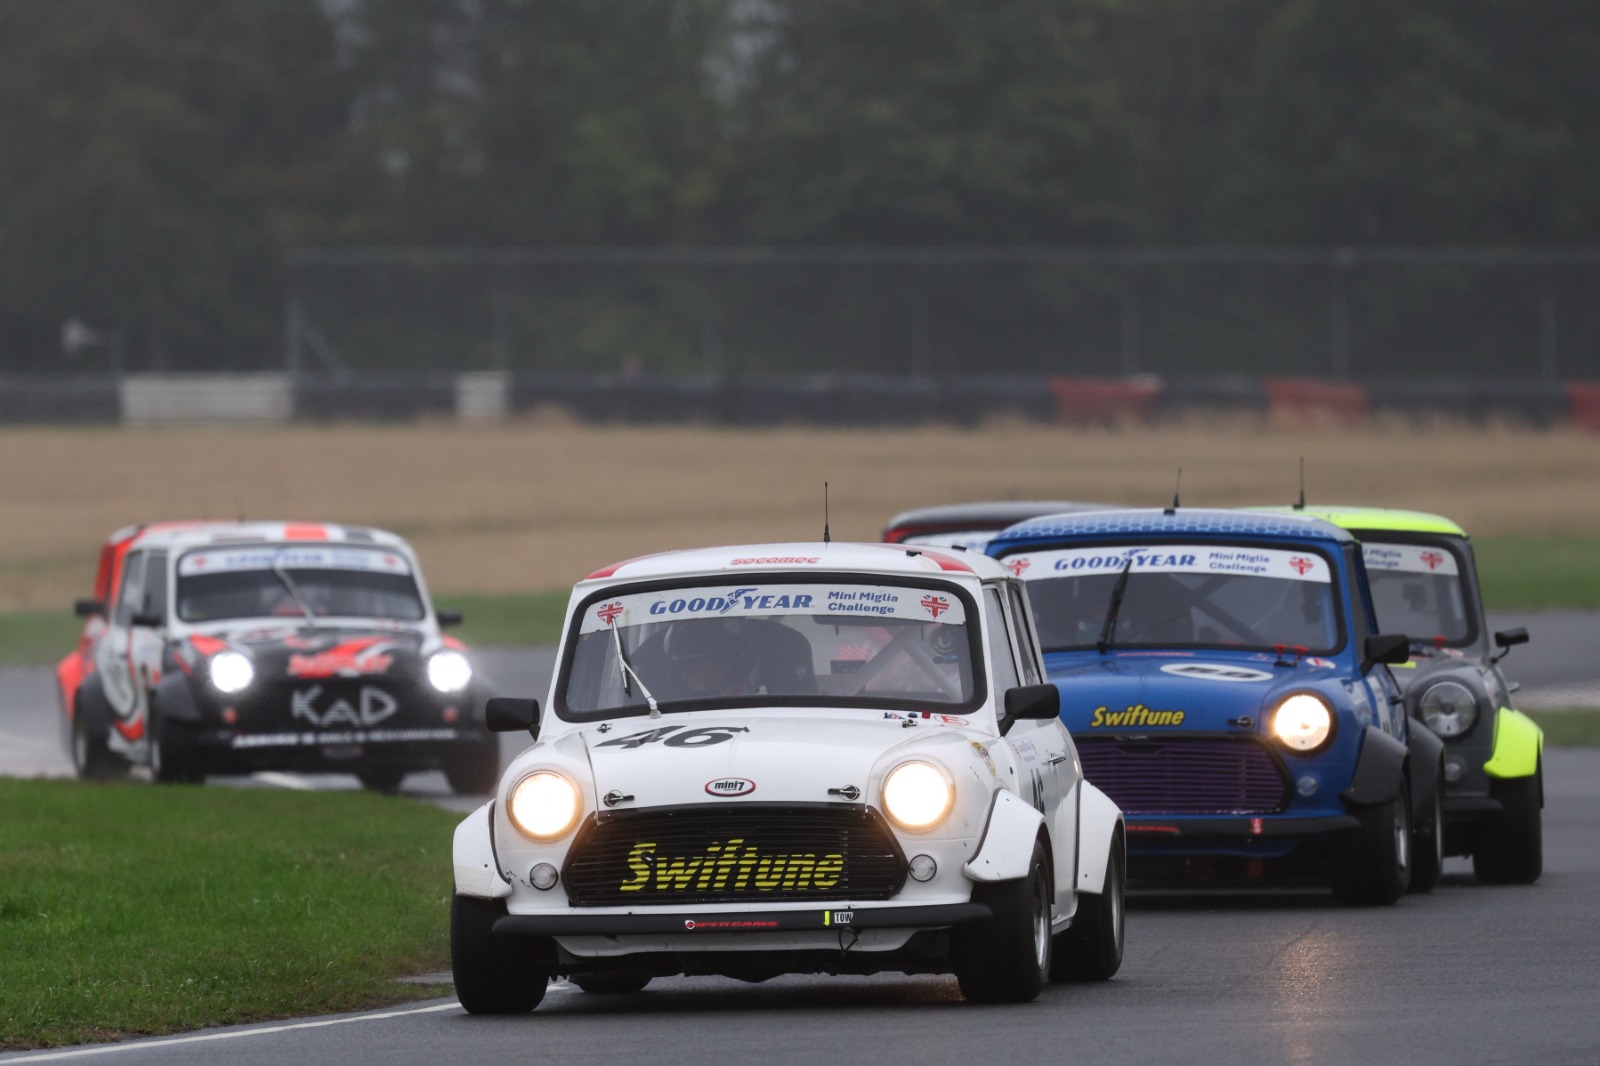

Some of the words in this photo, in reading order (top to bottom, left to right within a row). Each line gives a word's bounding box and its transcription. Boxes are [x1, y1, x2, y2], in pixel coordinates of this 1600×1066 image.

[1209, 552, 1233, 561] Mini
[1236, 553, 1270, 563] Miglia
[1209, 562, 1267, 573] Challenge
[827, 591, 856, 600] Mini
[860, 592, 899, 603] Miglia
[827, 602, 895, 614] Challenge
[1091, 704, 1185, 727] Swiftune
[594, 725, 746, 749] 46
[620, 839, 844, 891] Swiftune
[835, 912, 852, 923] TOW
